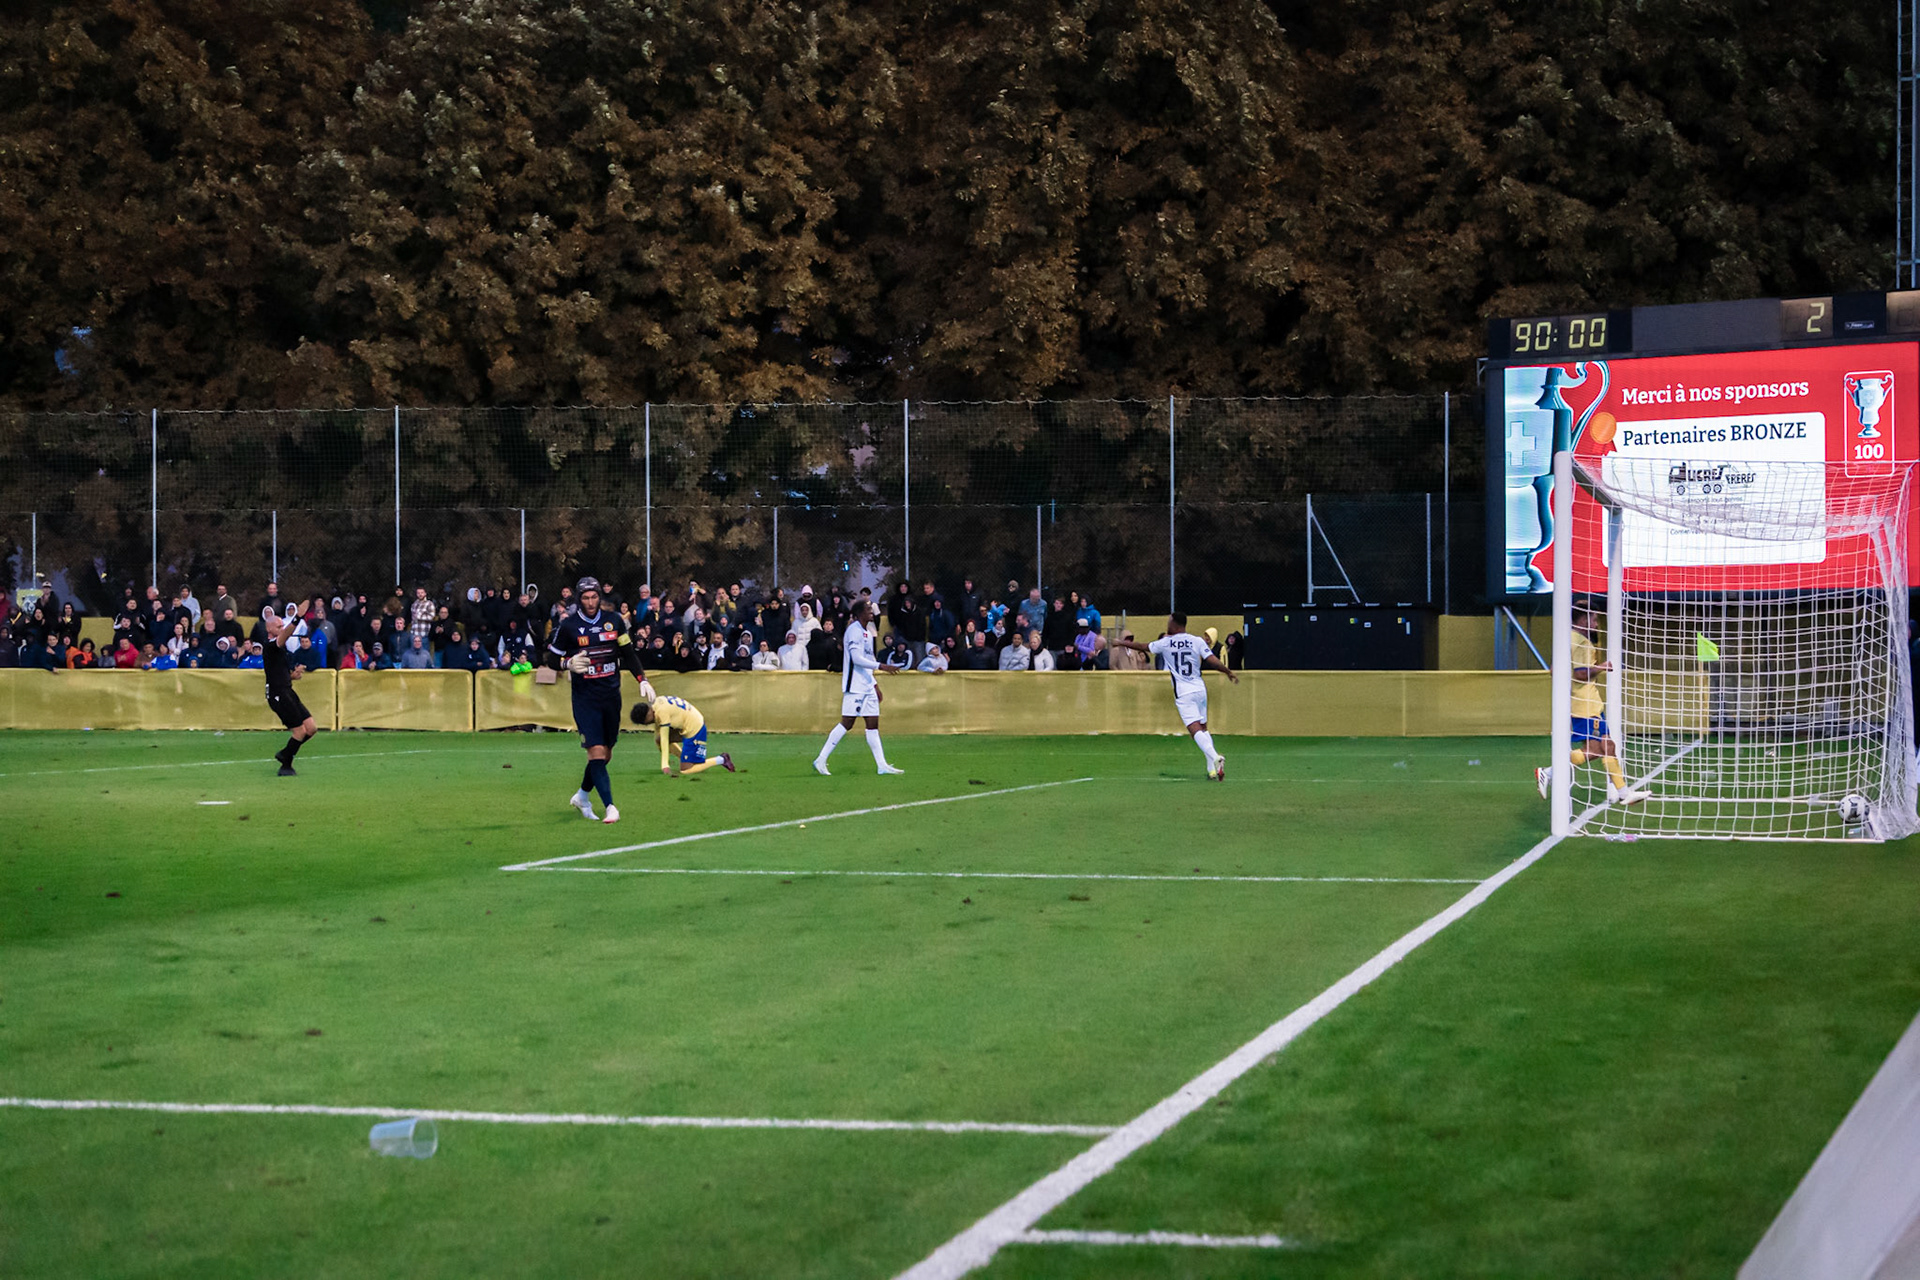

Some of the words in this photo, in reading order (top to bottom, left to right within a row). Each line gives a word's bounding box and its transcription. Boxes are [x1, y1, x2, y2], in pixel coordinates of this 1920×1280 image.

[1807, 302, 1825, 333] 2
[1621, 384, 1673, 405] Merci
[1675, 383, 1687, 403] à
[1688, 386, 1722, 402] nos
[1724, 381, 1809, 404] sponsors
[1623, 425, 1727, 447] Partenaires
[1730, 421, 1807, 442] BRONZE
[1854, 443, 1884, 460] 100
[1171, 652, 1193, 677] 15
